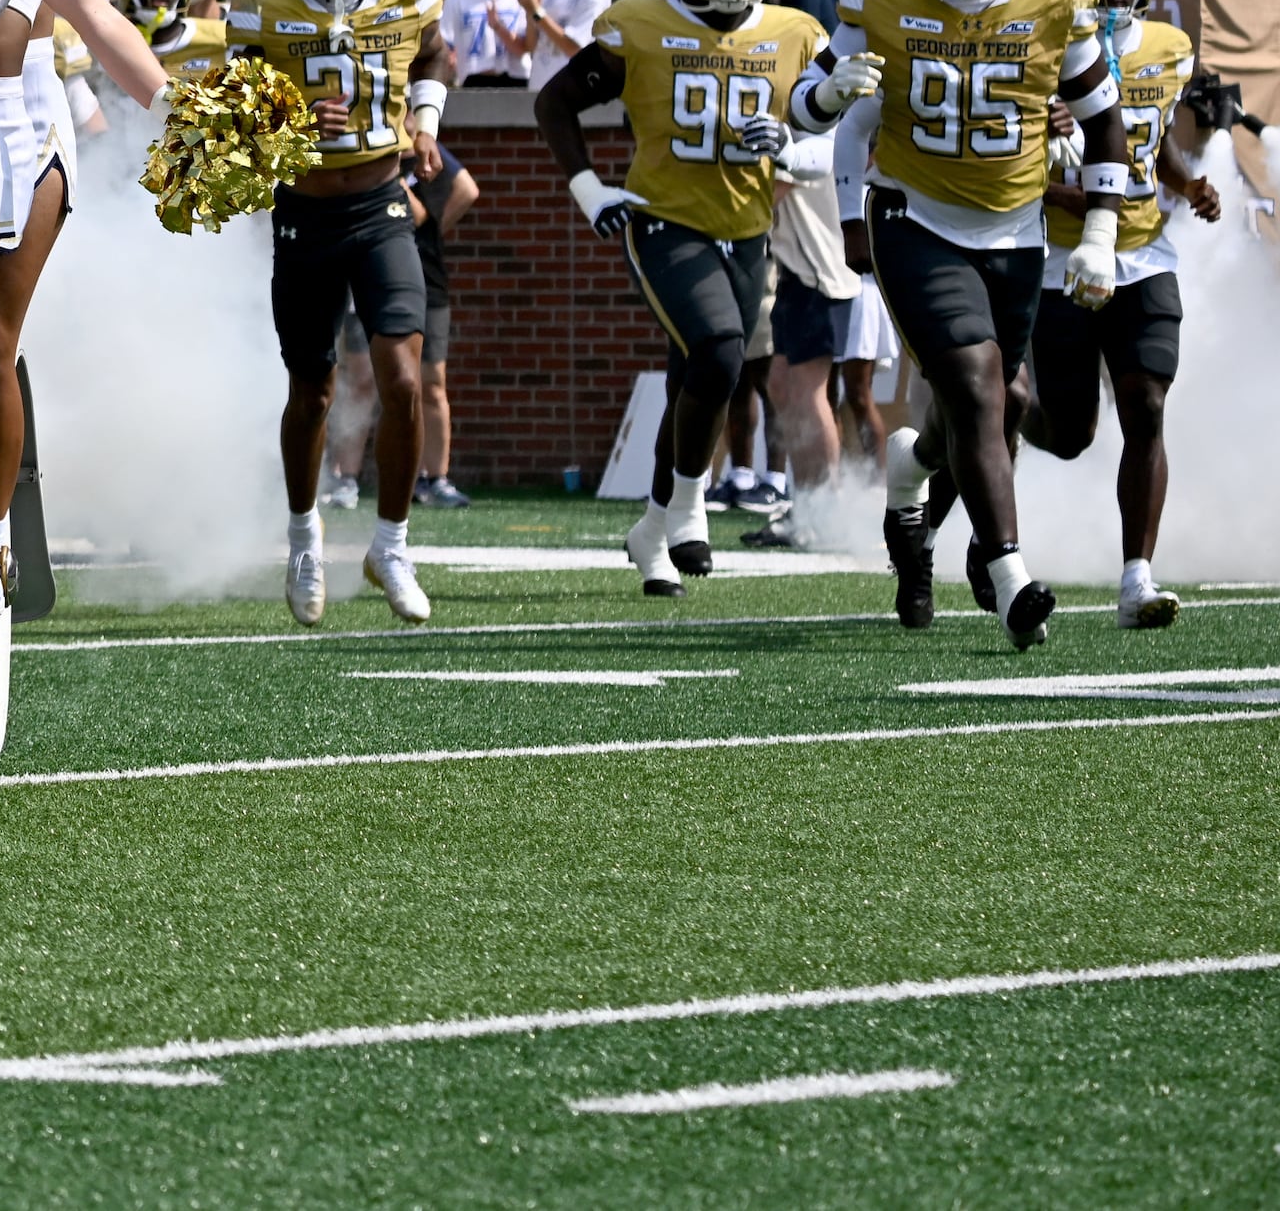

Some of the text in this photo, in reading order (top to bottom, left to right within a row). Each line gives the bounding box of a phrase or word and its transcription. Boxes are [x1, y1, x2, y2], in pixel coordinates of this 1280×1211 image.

[1000, 21, 1034, 33] ACC
[362, 32, 402, 49] TECH
[905, 38, 1030, 58] GEORGIA TECH
[671, 54, 777, 73] GEORGIA TECH
[304, 51, 398, 153] 21
[1127, 85, 1165, 102] TECH
[908, 56, 1025, 158] 95
